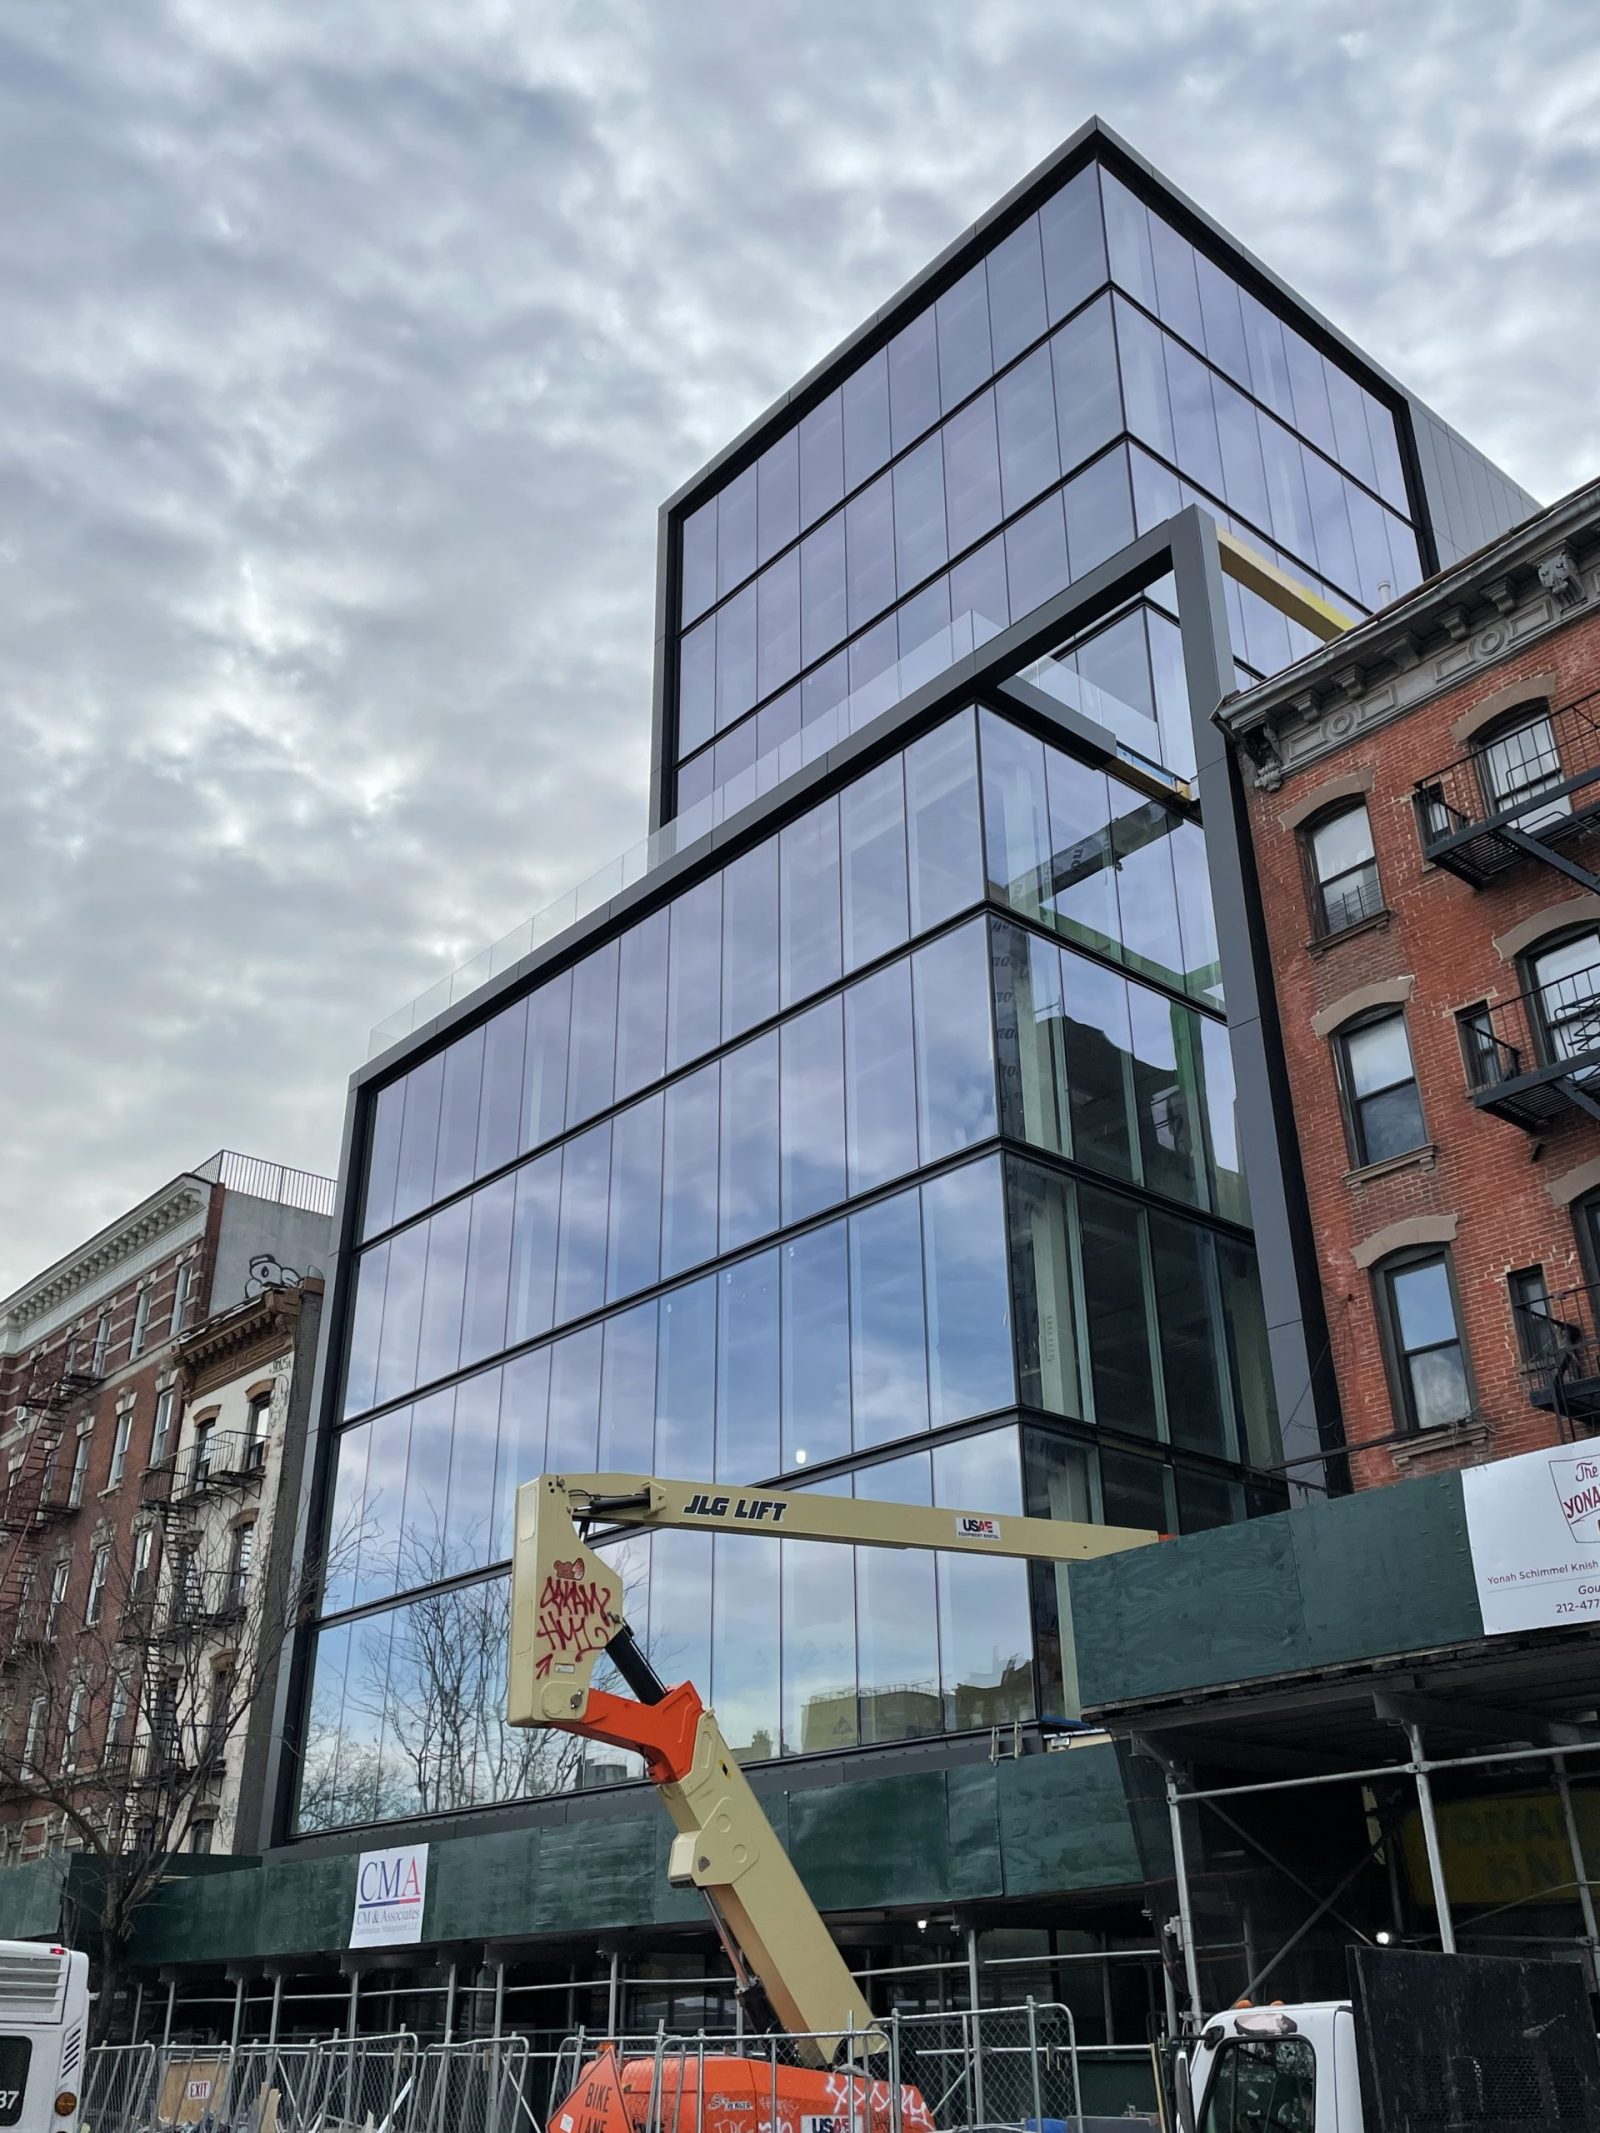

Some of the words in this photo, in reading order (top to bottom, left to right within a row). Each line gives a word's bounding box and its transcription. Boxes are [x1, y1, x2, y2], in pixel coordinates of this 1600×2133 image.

[1575, 1462, 1599, 1482] The
[683, 1495, 730, 1517] JLG
[735, 1499, 788, 1522] LIFT
[1563, 1484, 1600, 1519] YONA
[1487, 1573, 1517, 1584] Yonah
[1519, 1564, 1569, 1580] Schimmel
[1570, 1559, 1599, 1572] Knish
[361, 1856, 421, 1902] CMA
[357, 1910, 371, 1925] CM
[372, 1909, 379, 1924] &
[381, 1908, 420, 1922] Associates
[189, 2082, 209, 2098] EXIT
[585, 2082, 612, 2113] BIKE
